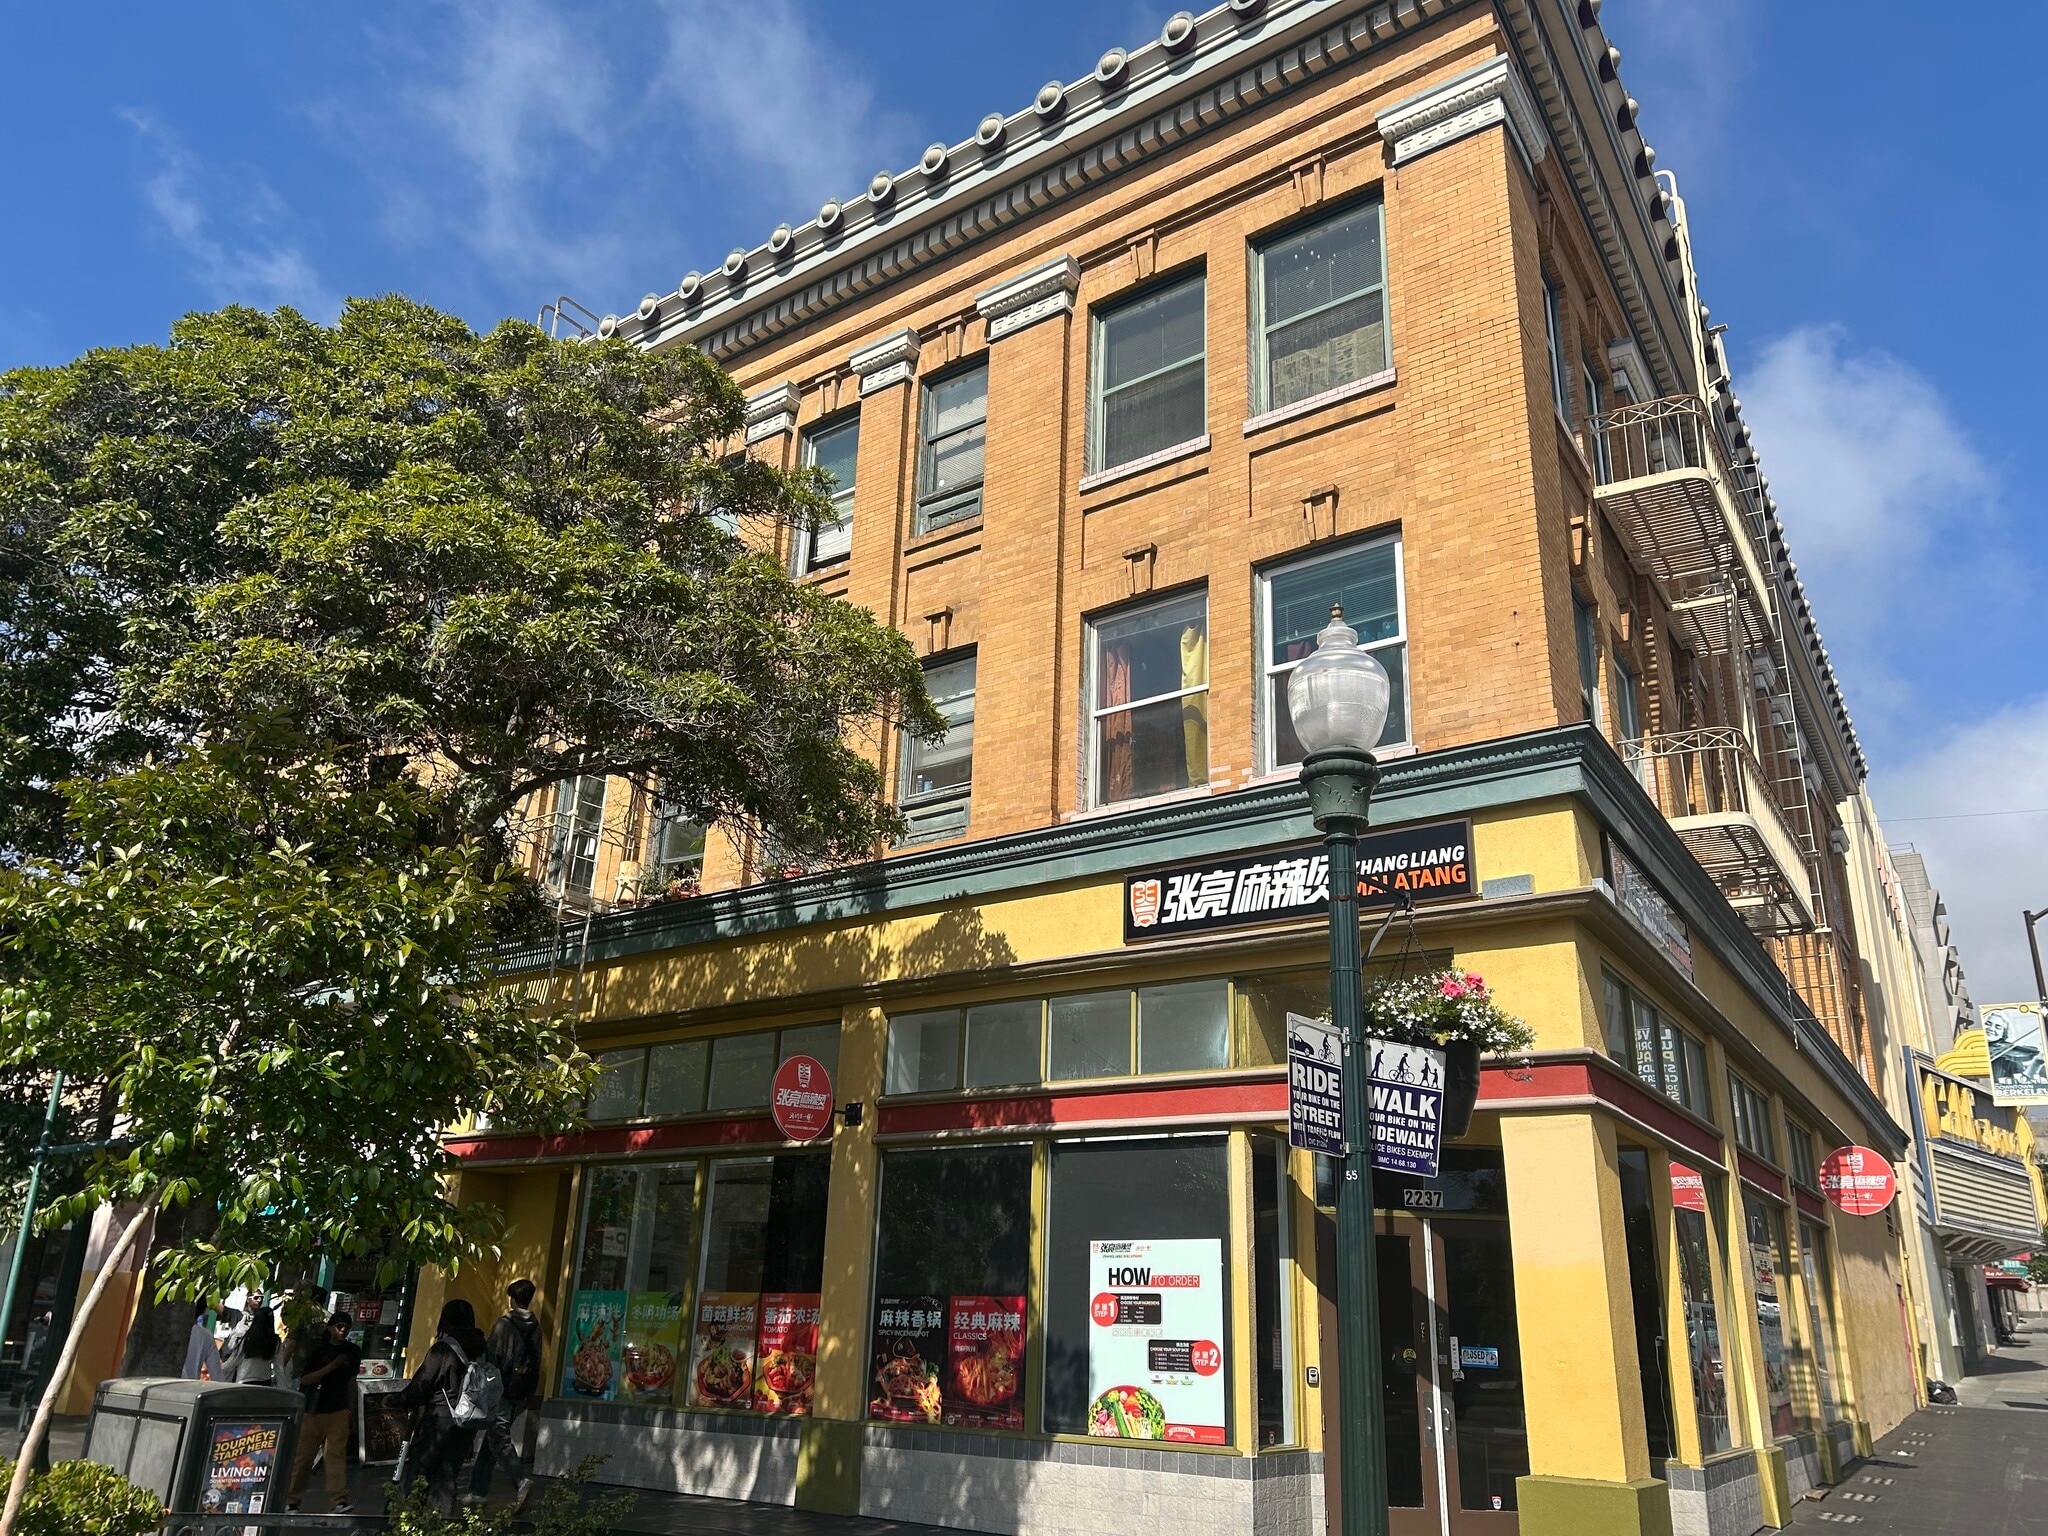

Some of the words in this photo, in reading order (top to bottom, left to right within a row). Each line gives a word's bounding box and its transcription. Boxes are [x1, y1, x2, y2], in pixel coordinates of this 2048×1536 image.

[1410, 845, 1465, 868] LIANG
[1293, 1062, 1341, 1098] RIDE
[1293, 1089, 1307, 1102] YOUR
[1308, 1093, 1321, 1105] BIKE
[1321, 1097, 1329, 1106] ON
[1330, 1099, 1340, 1110] THE
[1367, 1085, 1437, 1120] WALK
[1293, 1102, 1341, 1128] STREET
[1369, 1112, 1386, 1123] OUR
[1387, 1114, 1406, 1126] BIKE
[1408, 1118, 1419, 1129] ON
[1421, 1121, 1436, 1132] THE
[1307, 1124, 1327, 1137] TRAFFIC
[1328, 1129, 1341, 1140] FLOW
[1387, 1145, 1406, 1156] BIKES
[1407, 1148, 1434, 1160] EXEMPT
[1346, 1169, 1358, 1181] 55
[1405, 1190, 1442, 1207] 2237
[1108, 1267, 1151, 1286] HOW
[1153, 1276, 1166, 1286] TO
[1168, 1275, 1199, 1287] ORDER
[360, 1309, 379, 1319] EBT
[701, 1305, 754, 1324] 菌菇鲜汤
[764, 1307, 820, 1325] 番茄浓汤
[879, 1309, 942, 1329] 麻辣香锅
[1094, 1310, 1108, 1318] STEP
[1108, 1301, 1115, 1318] 1
[763, 1326, 789, 1334] TOMATO
[953, 1311, 1021, 1332] 经典麻辣
[878, 1329, 894, 1337] SPICY
[953, 1332, 987, 1341] CLASSICS
[1209, 1348, 1218, 1367] 2
[213, 1446, 246, 1462] START
[247, 1440, 274, 1453] HERE
[214, 1430, 277, 1453] JOURNEYS
[211, 1466, 252, 1478] LIVING
[254, 1466, 268, 1476] IN
